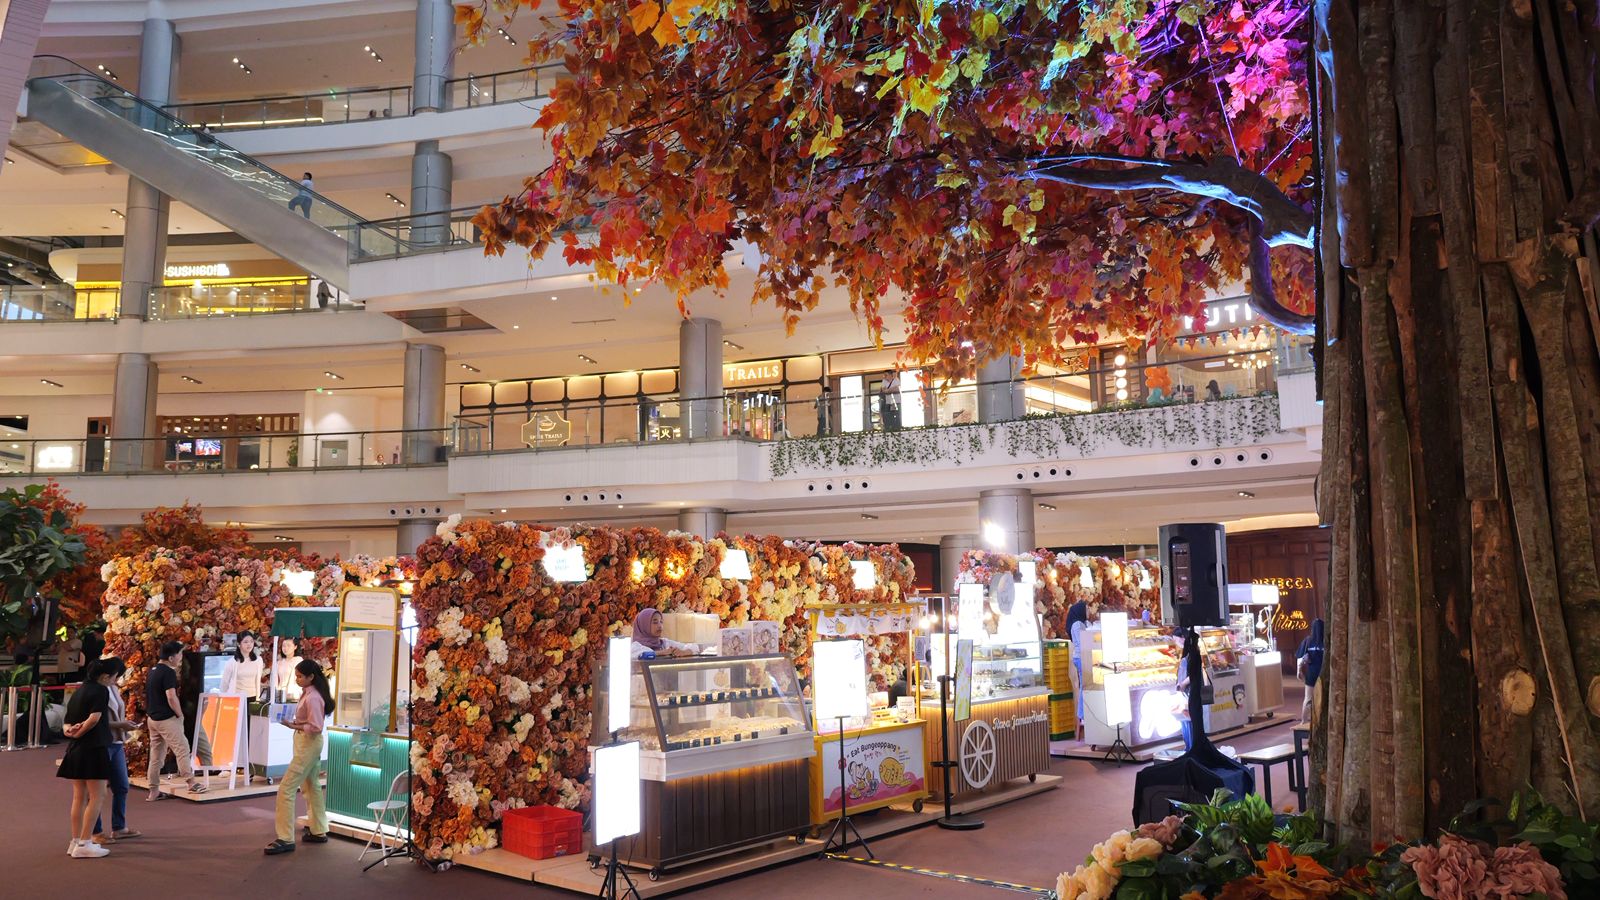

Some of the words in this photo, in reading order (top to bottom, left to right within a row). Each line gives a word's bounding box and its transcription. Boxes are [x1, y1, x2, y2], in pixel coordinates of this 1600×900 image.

[1184, 303, 1254, 330] UTI
[727, 366, 779, 380] TRAILS
[850, 747, 860, 758] Eat
[860, 741, 897, 753] Bungeoppang
